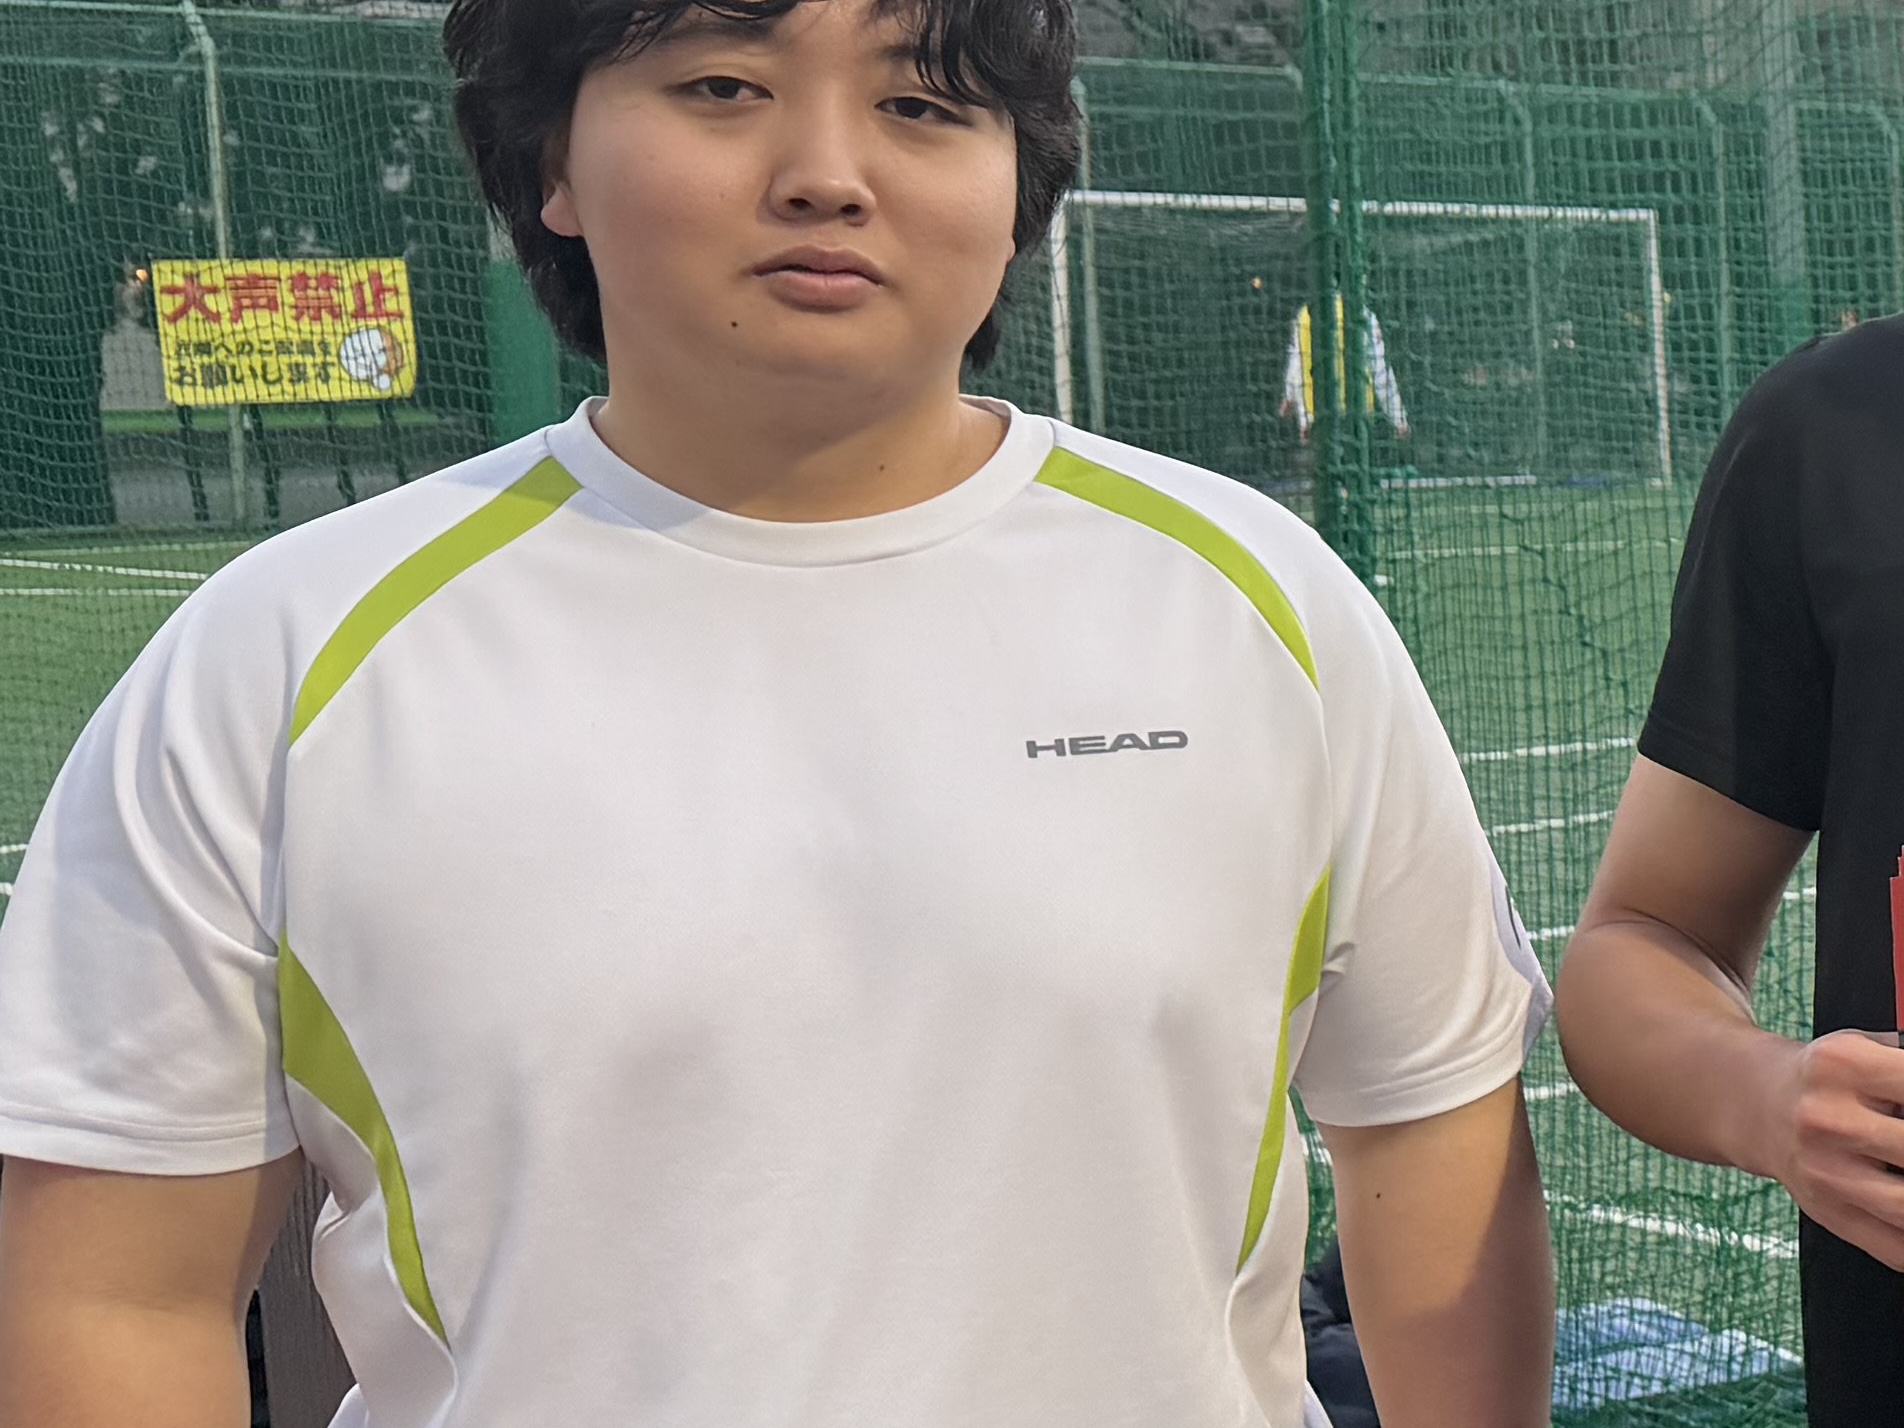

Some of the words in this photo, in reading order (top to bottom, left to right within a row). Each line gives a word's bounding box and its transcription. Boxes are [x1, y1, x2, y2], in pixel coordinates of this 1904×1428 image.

[161, 270, 404, 323] 大声禁止
[1026, 730, 1188, 759] HEAD
